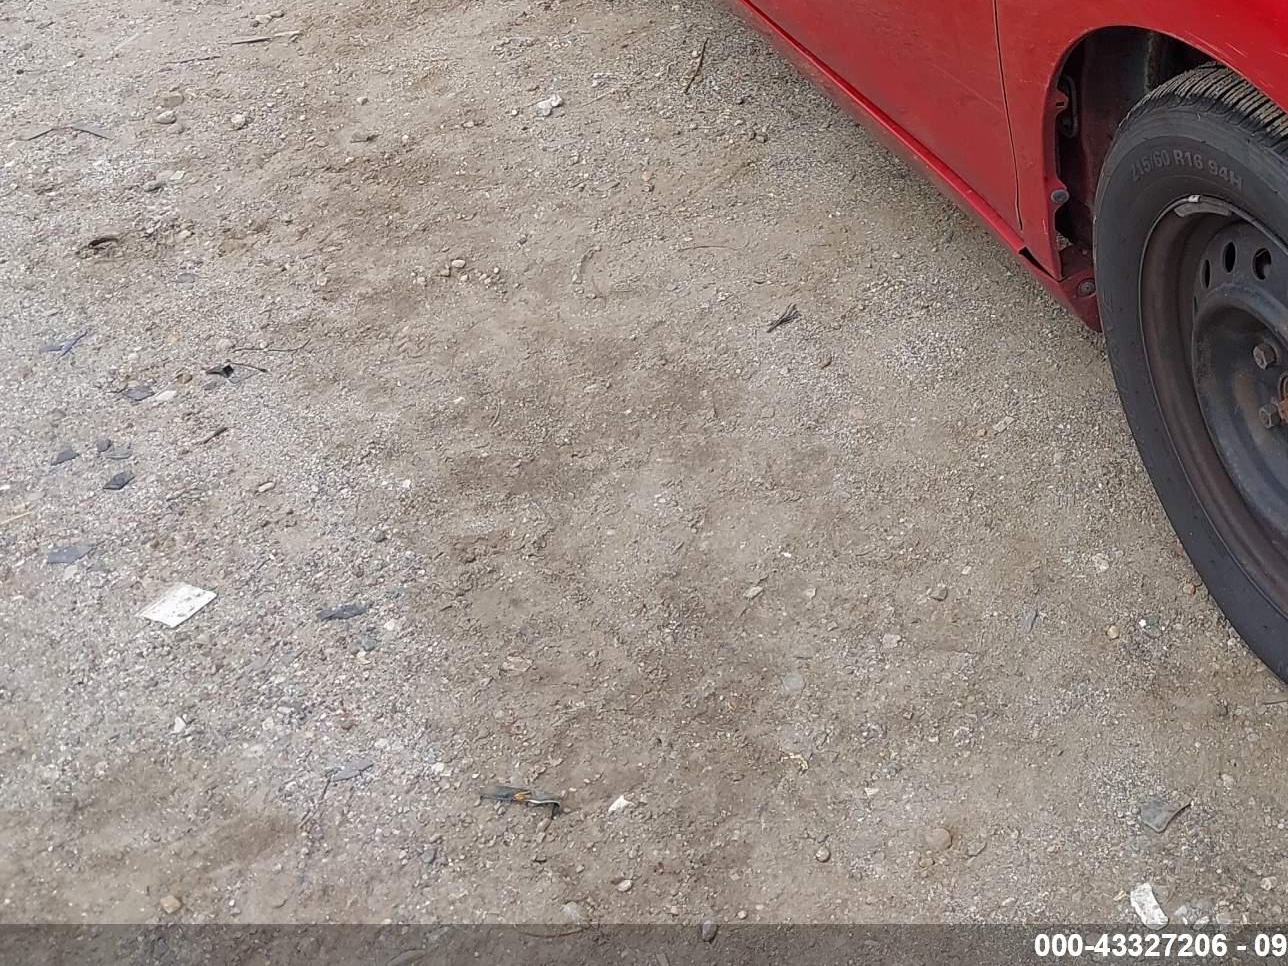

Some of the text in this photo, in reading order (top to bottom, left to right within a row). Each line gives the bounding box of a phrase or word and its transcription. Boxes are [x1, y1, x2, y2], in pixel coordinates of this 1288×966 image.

[1130, 149, 1243, 189] 215/60 R16 94H
